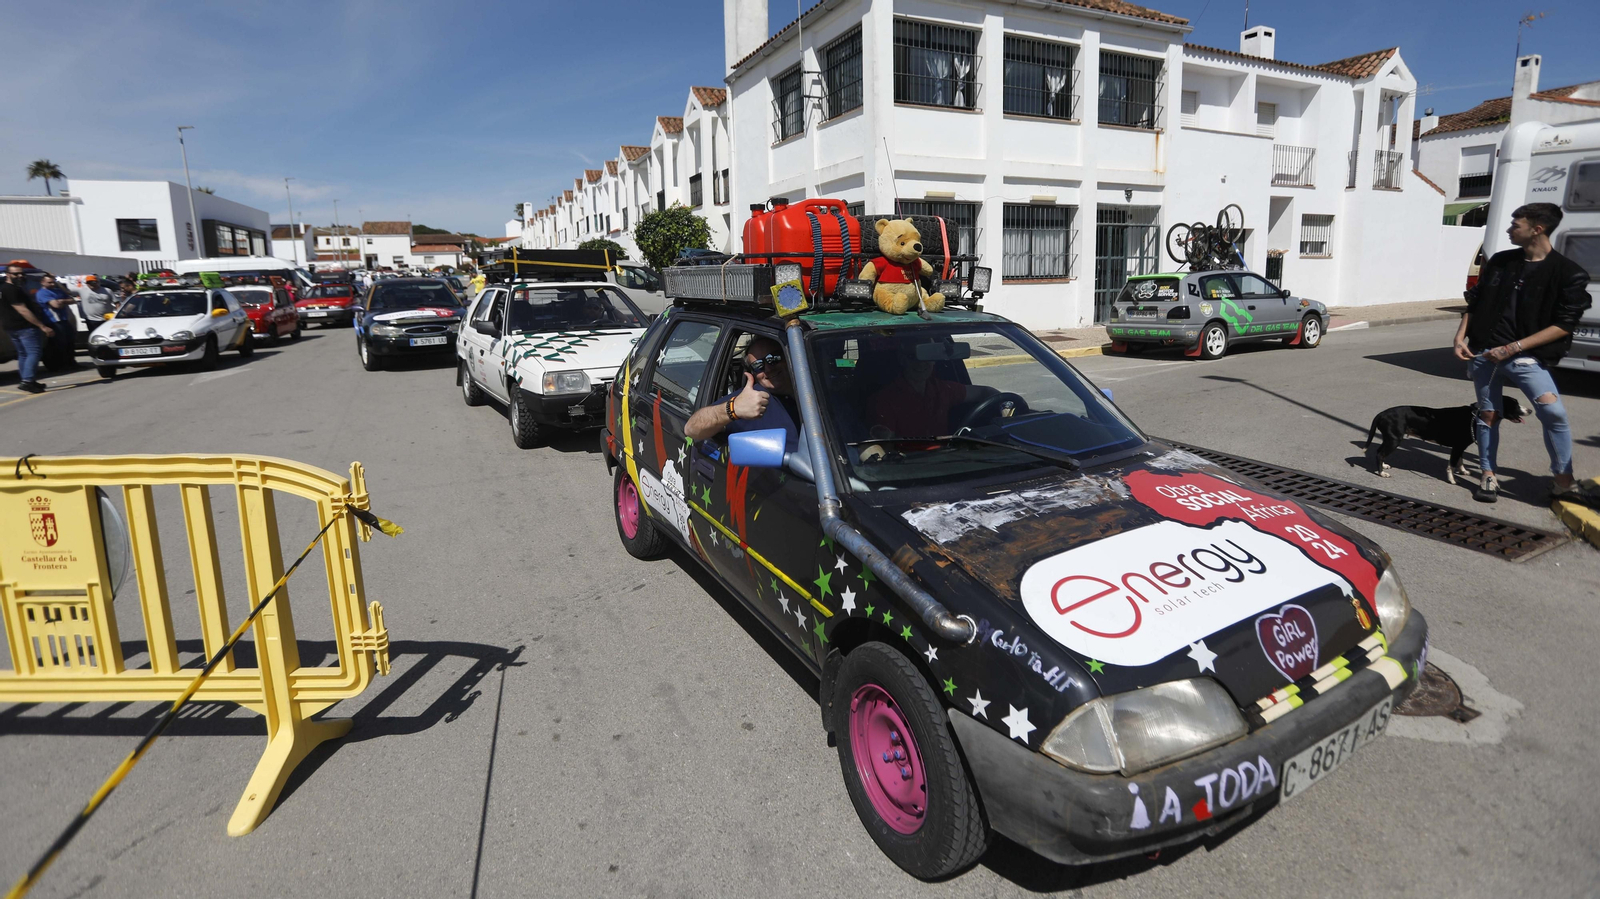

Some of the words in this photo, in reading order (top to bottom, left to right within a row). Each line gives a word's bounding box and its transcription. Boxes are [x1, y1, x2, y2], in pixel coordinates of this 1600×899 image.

[1112, 327, 1126, 336] DEL
[1127, 328, 1147, 337] GAS
[1148, 329, 1171, 337] TEAM
[1251, 325, 1264, 333] DEL
[1282, 322, 1299, 330] TEAM
[1155, 484, 1205, 499] Obra
[1176, 489, 1253, 511] SOCIAL
[1236, 503, 1297, 522] África
[1284, 524, 1321, 543] 20
[21, 554, 56, 563] Castellar
[58, 554, 68, 562] de
[69, 554, 78, 562] la
[1310, 539, 1349, 560] 24
[1050, 538, 1268, 639] energy
[1154, 595, 1192, 616] solar
[1193, 581, 1226, 599] tech
[1194, 755, 1277, 814] TODA
